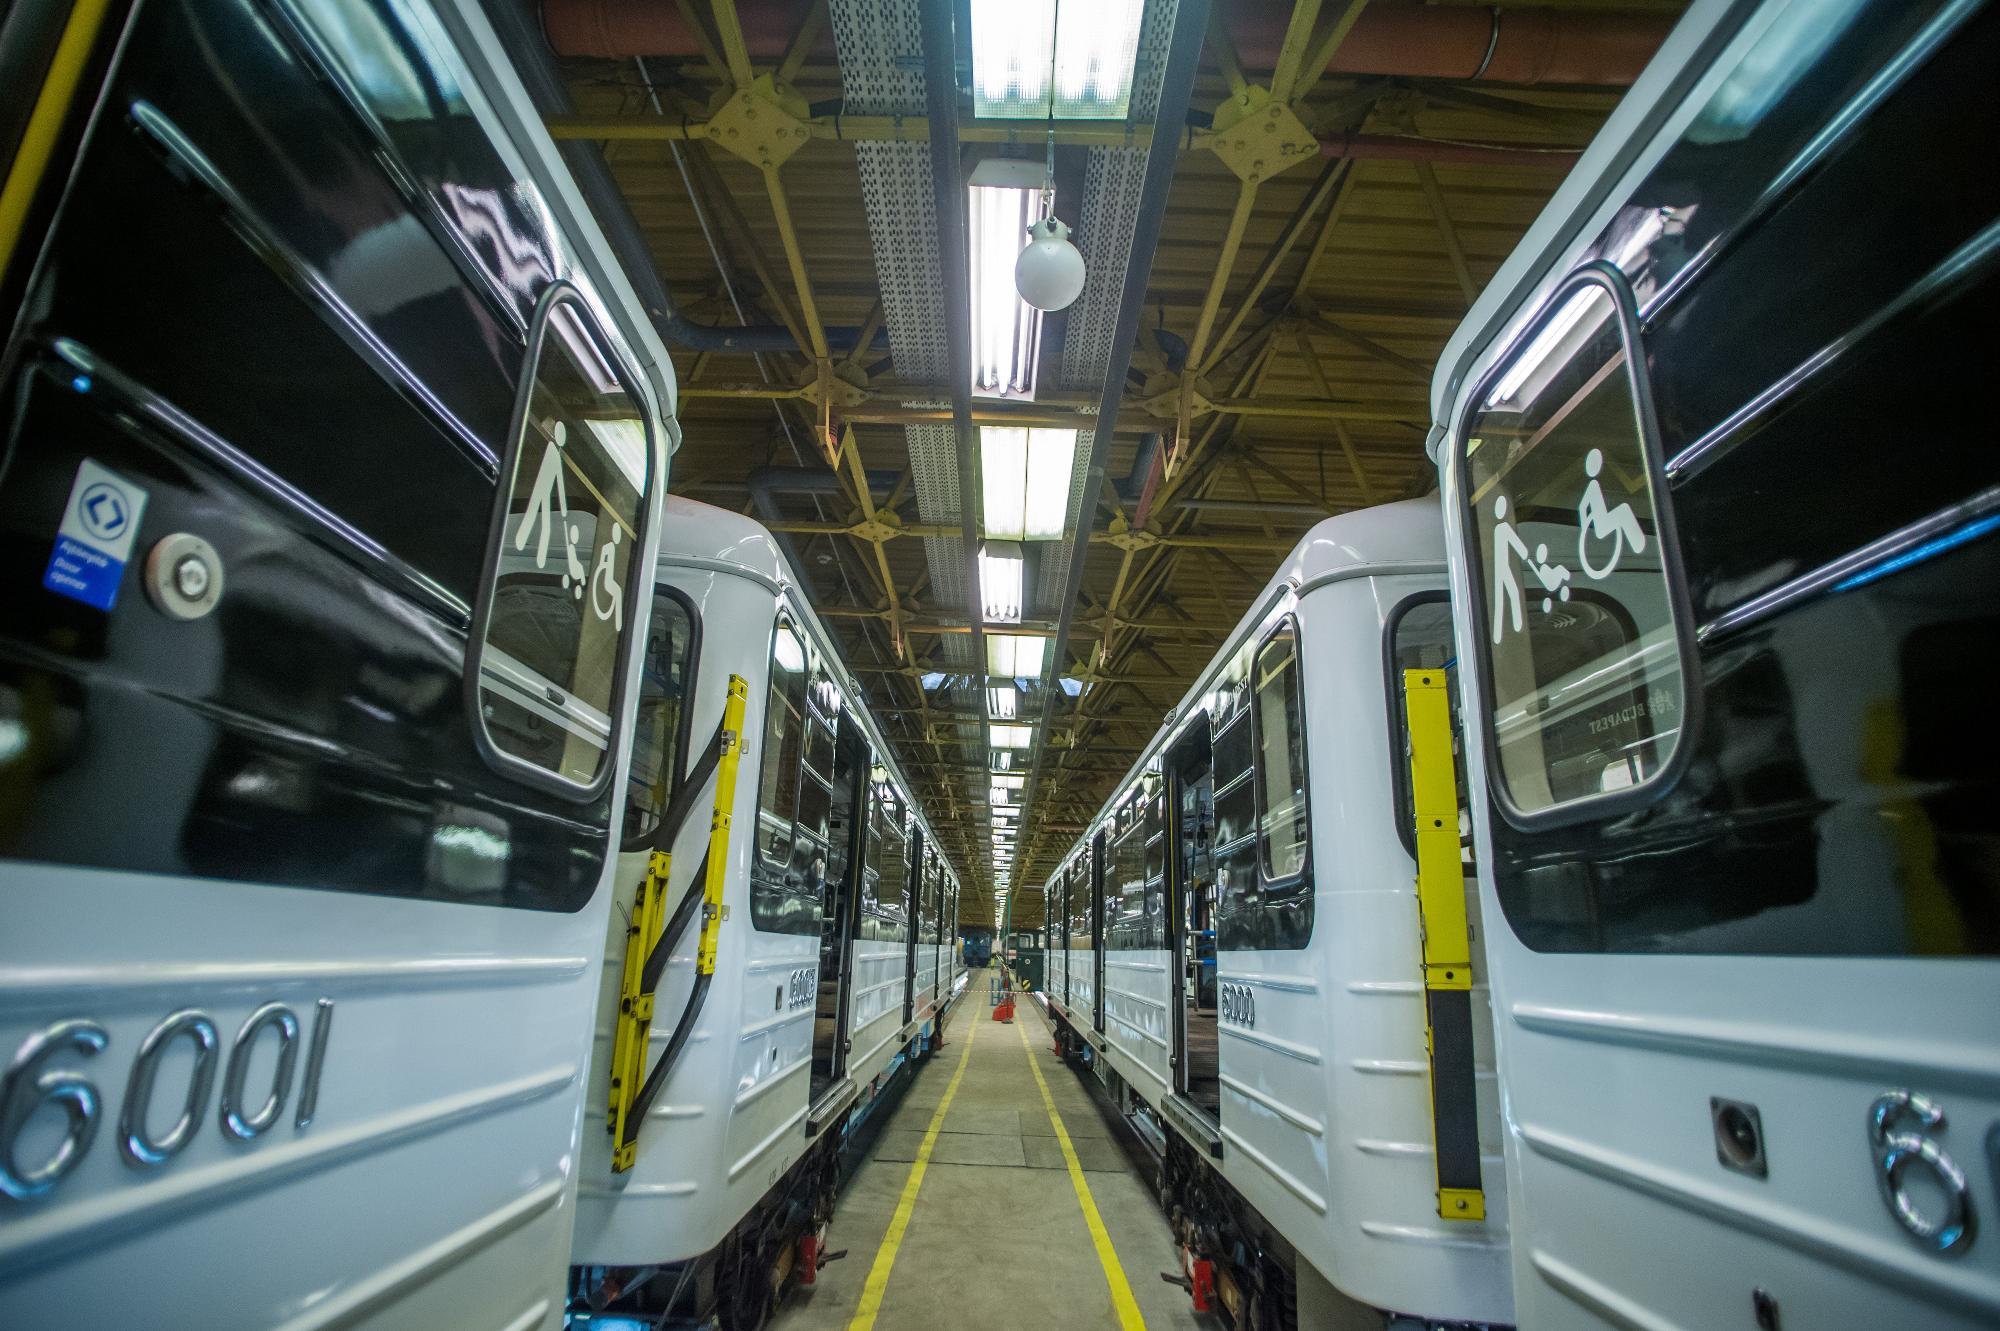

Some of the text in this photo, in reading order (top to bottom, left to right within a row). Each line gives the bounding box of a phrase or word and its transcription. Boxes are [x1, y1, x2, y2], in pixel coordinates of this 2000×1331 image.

[1222, 982, 1255, 1029] 6000
[0, 996, 335, 1200] 6001
[1867, 1087, 2000, 1262] 6
